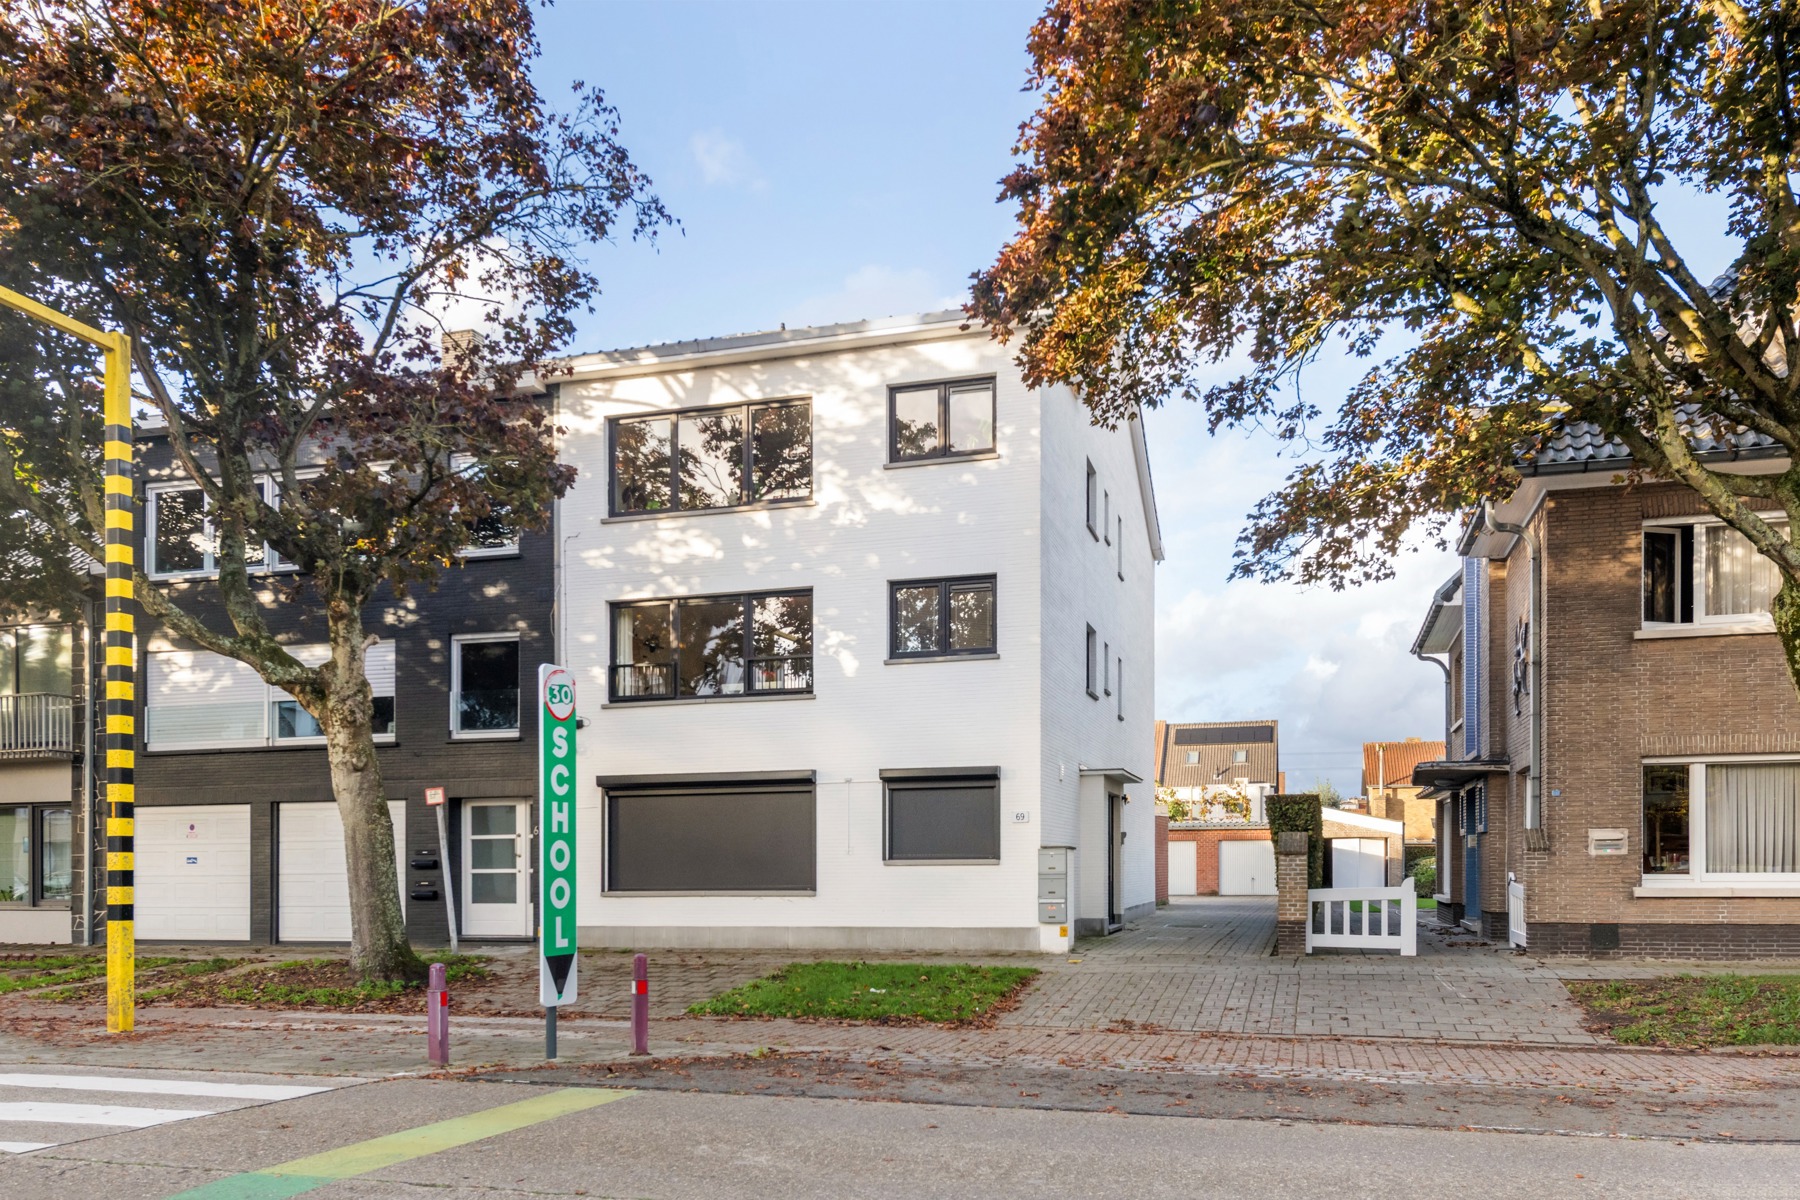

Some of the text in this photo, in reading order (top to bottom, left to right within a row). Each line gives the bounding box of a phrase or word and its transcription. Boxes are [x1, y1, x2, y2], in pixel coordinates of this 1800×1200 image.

[550, 684, 572, 705] 30
[1015, 812, 1025, 821] 69
[550, 726, 571, 948] SCHOOL
